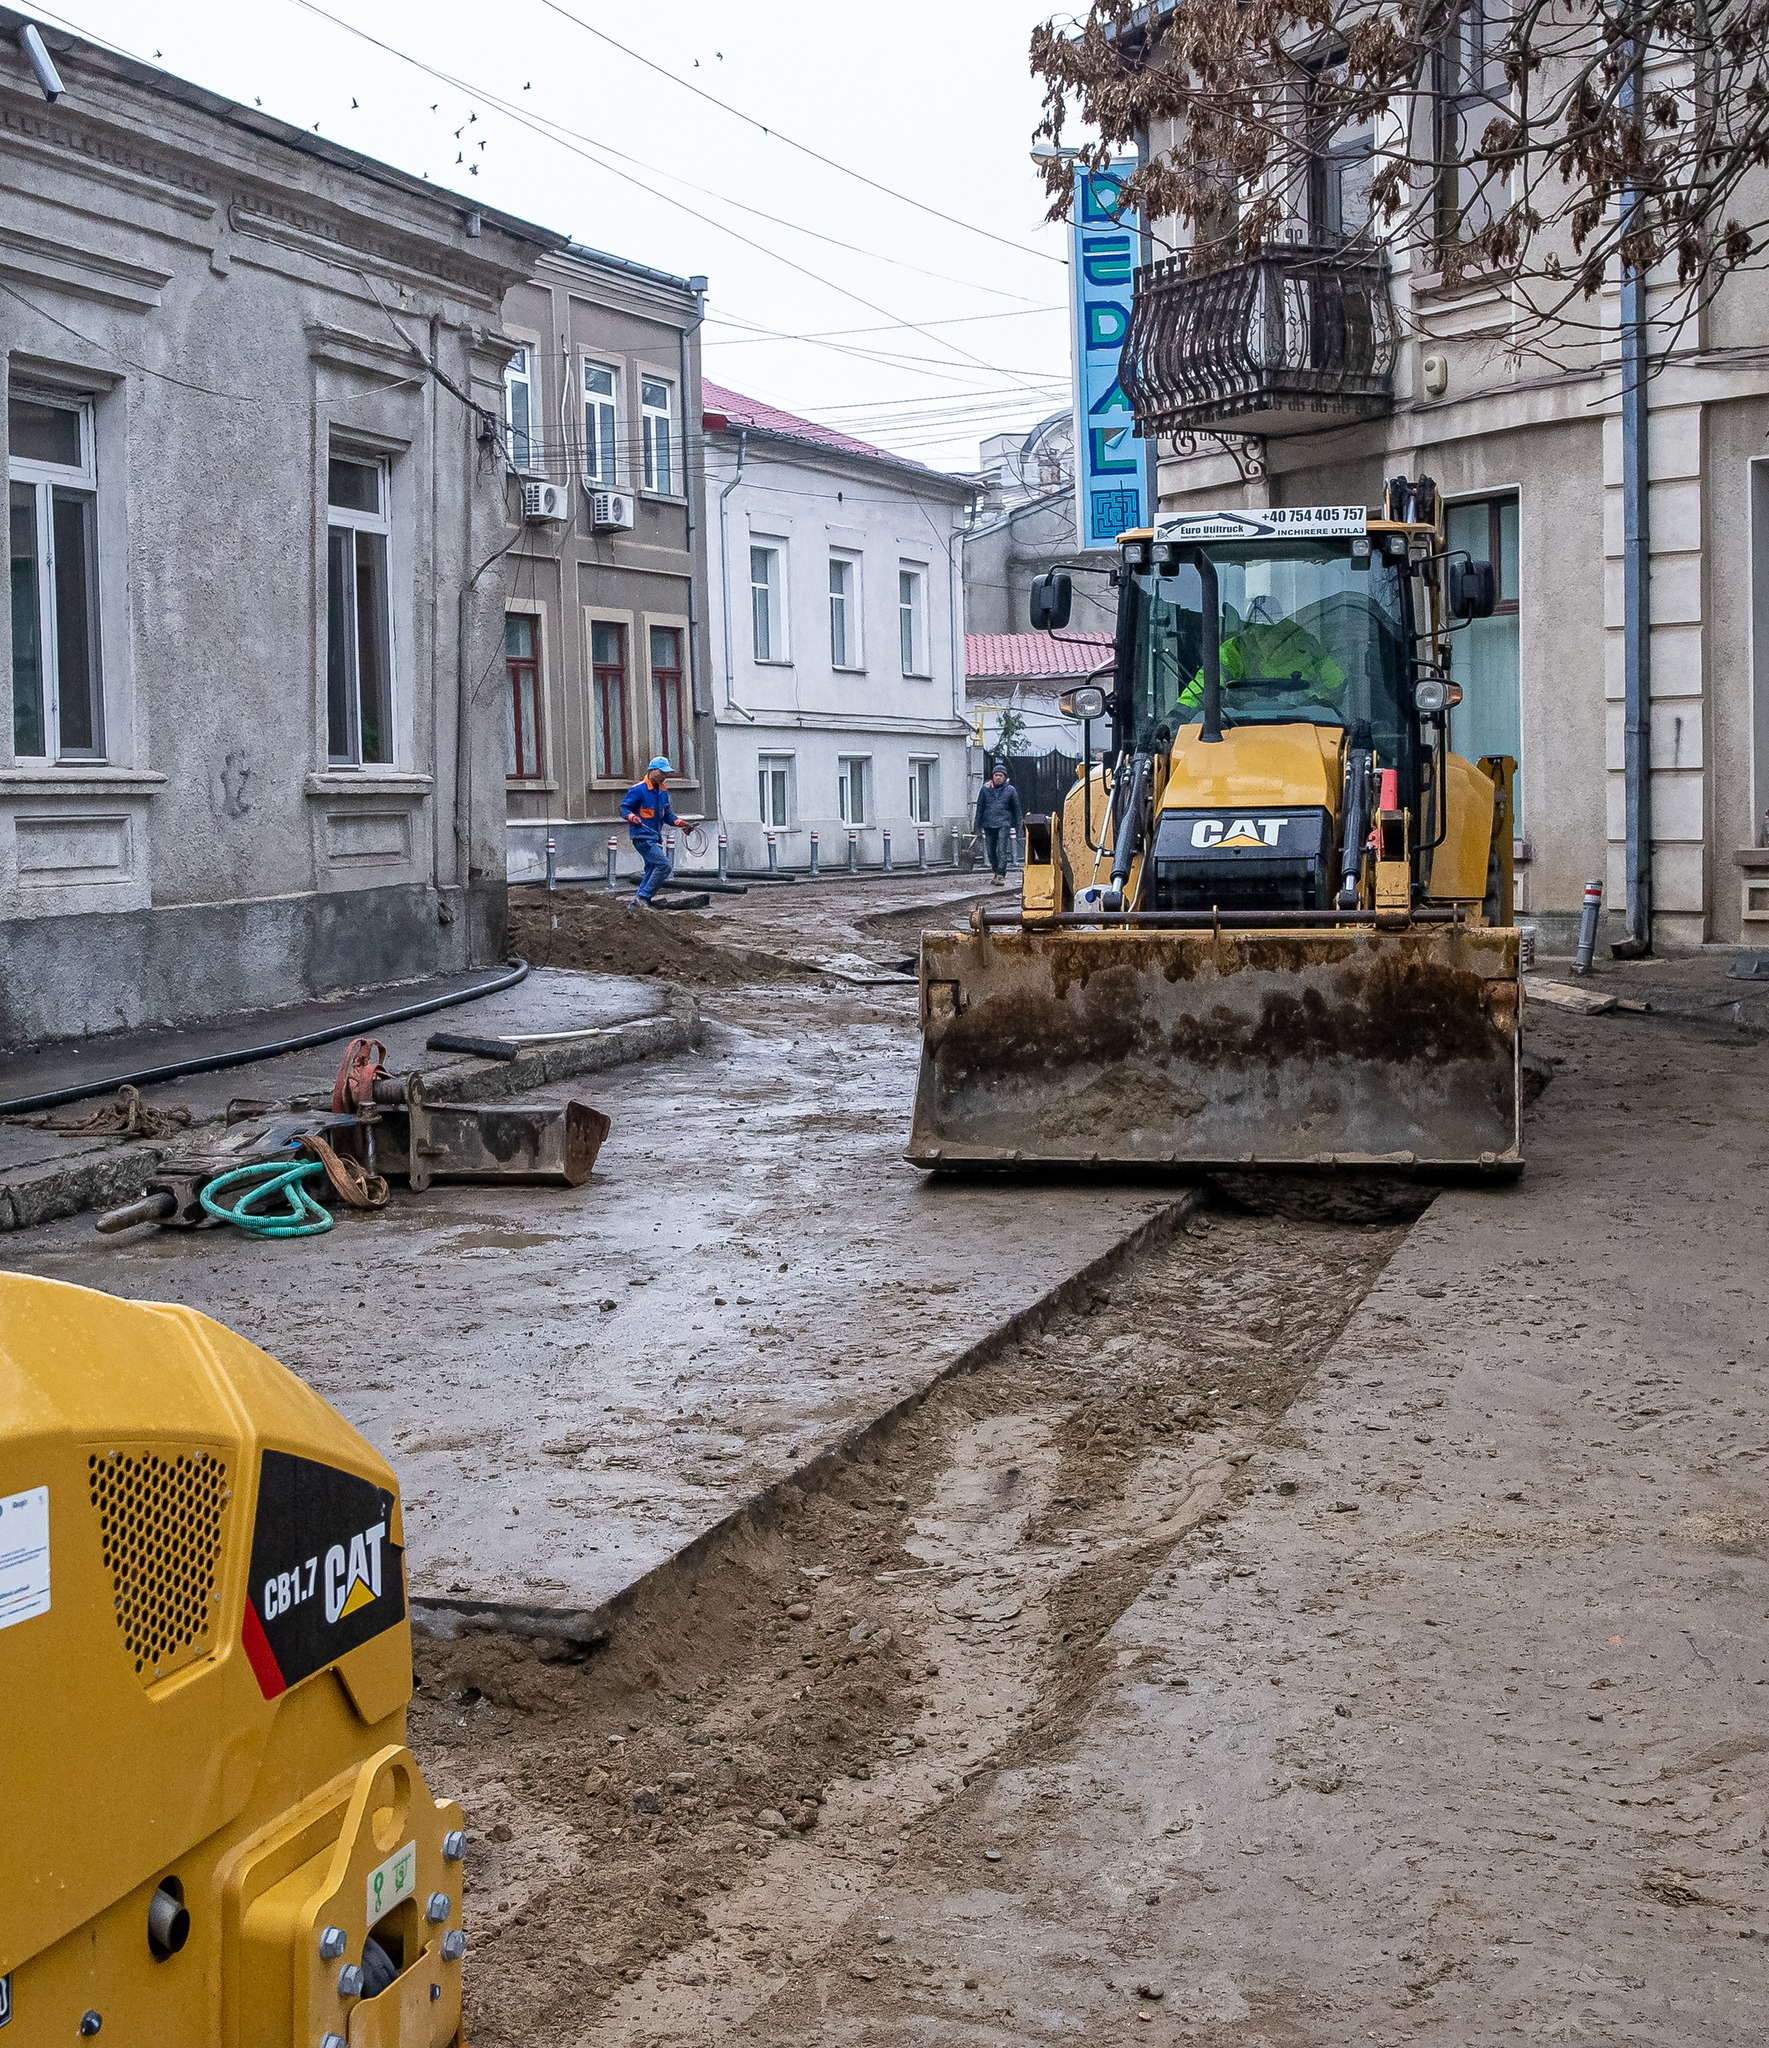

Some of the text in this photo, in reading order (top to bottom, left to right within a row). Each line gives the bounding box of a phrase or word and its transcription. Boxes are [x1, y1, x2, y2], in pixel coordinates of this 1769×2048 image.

[1261, 508, 1364, 523] +40 754 405 757
[1180, 525, 1244, 535] Euro Utiltruck
[1277, 527, 1365, 536] INCHIRERE UTILAJ
[1191, 818, 1289, 848] CAT
[264, 1520, 386, 1624] CB1.7 CAT
